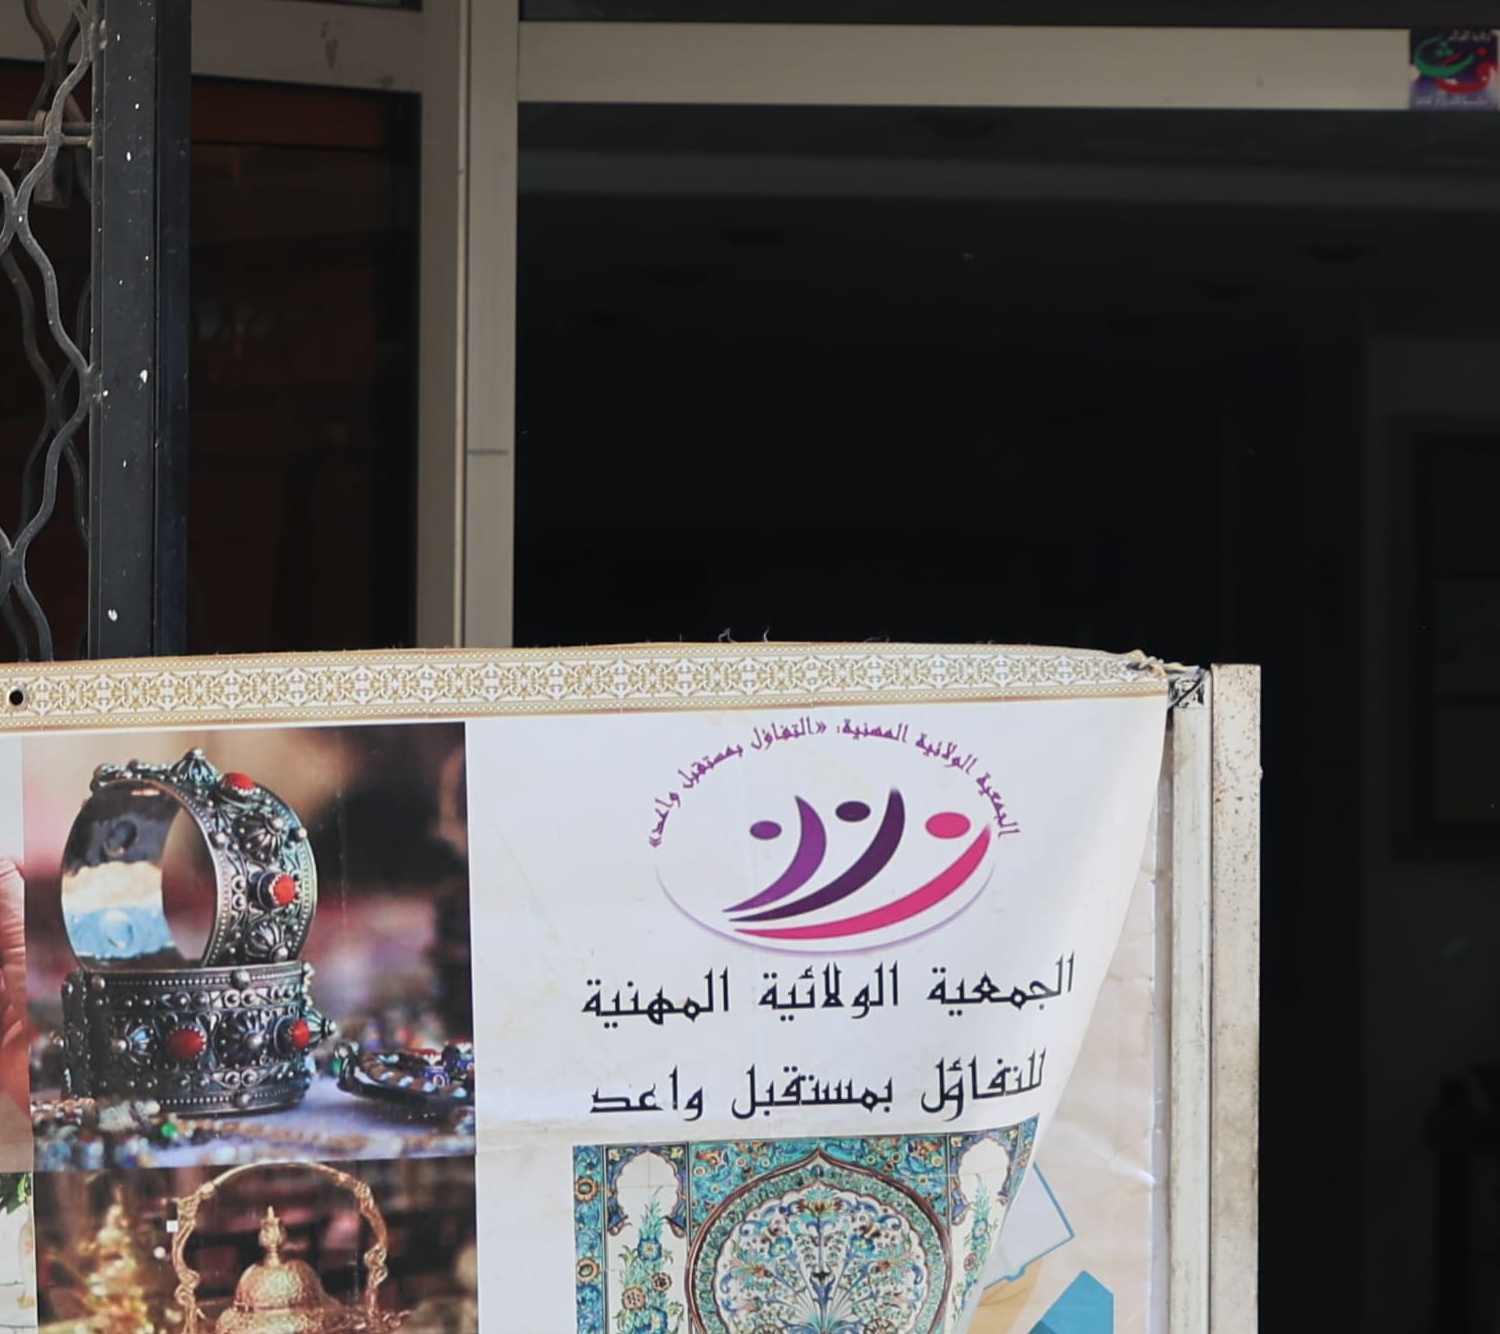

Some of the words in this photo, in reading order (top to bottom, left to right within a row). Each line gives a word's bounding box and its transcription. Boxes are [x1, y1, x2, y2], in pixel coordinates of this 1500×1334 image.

[581, 966, 729, 1029] المهنية
[758, 962, 899, 1022] الولائية
[927, 952, 1074, 1017] الجمعية
[590, 1066, 703, 1122] واعد
[731, 1064, 893, 1120] بمستقبل
[920, 1046, 1046, 1122] للتفاؤل
